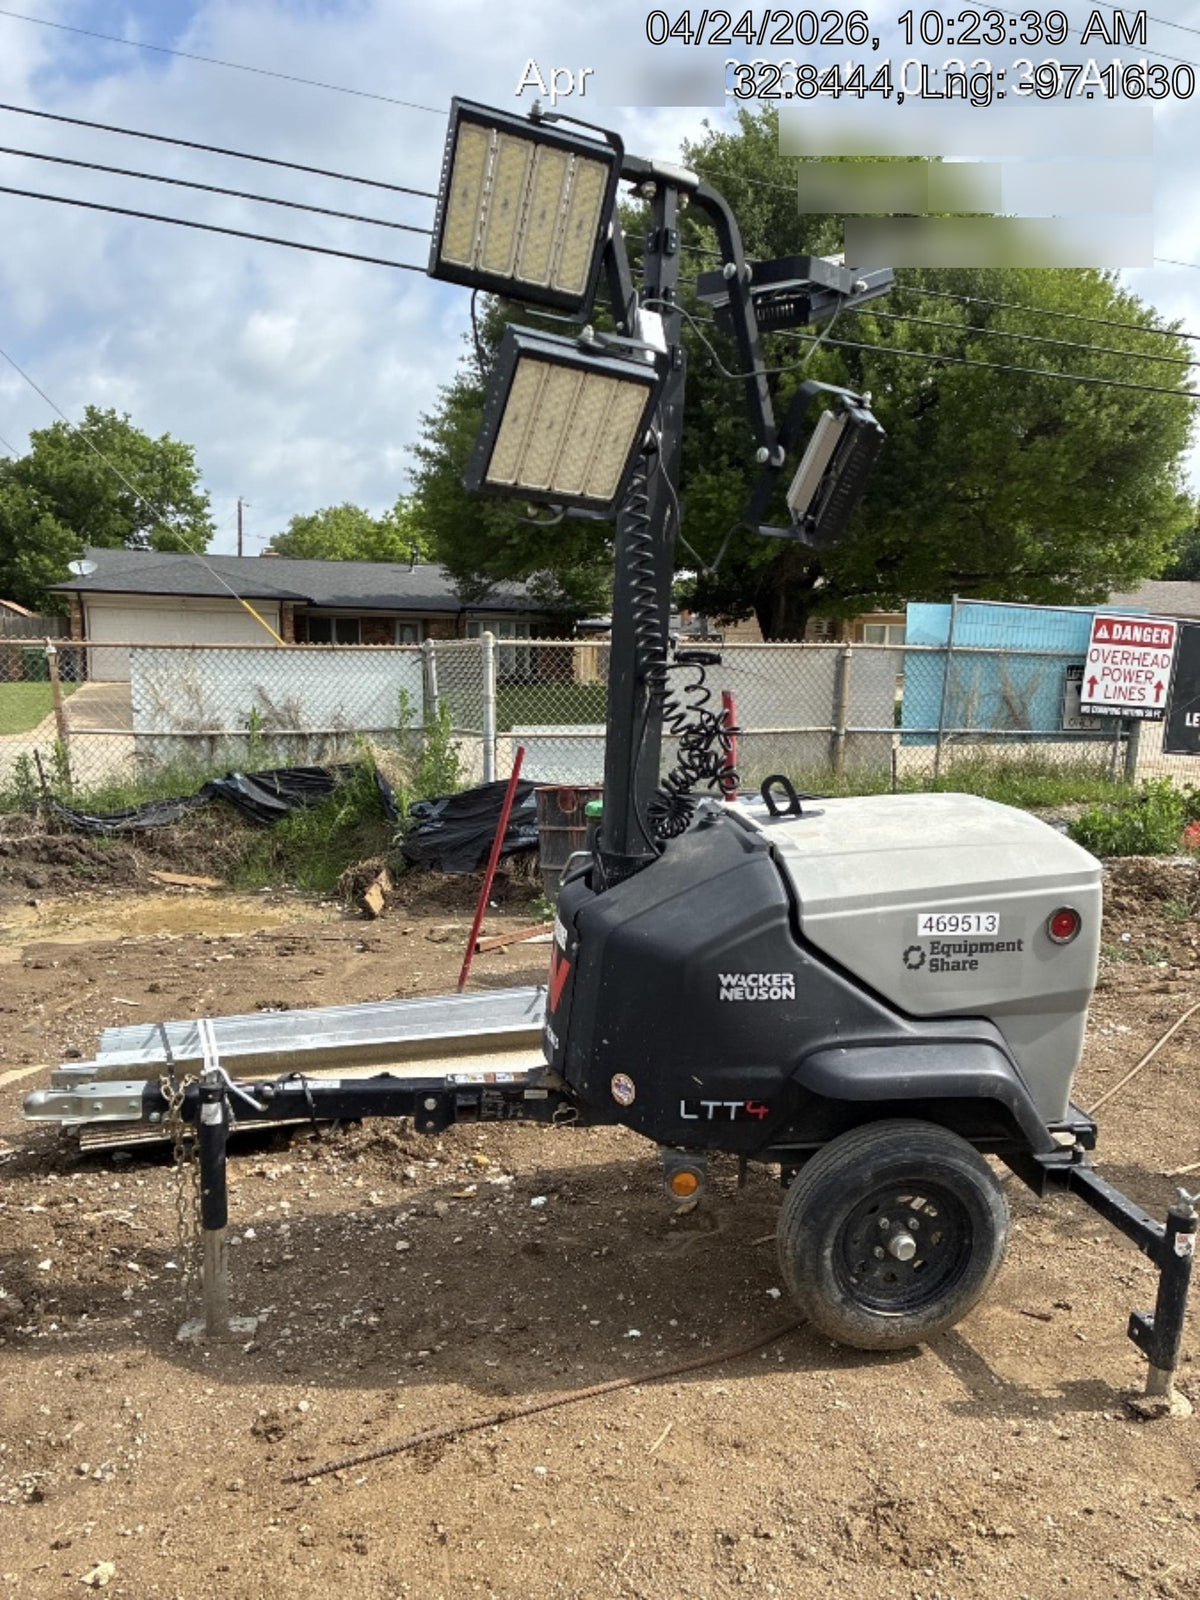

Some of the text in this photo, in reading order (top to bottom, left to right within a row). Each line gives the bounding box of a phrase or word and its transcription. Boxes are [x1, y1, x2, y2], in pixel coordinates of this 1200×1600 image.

[1112, 624, 1170, 644] DANGER
[1089, 648, 1171, 669] OVERHEAD
[1101, 667, 1155, 685] POWER
[1103, 684, 1146, 702] LINES
[922, 915, 997, 932] 469513
[929, 938, 1024, 957] Equipment
[929, 958, 979, 973] Share
[718, 973, 795, 987] WACKER
[718, 986, 796, 1001] NEUSON
[680, 1100, 769, 1120] LTT4
